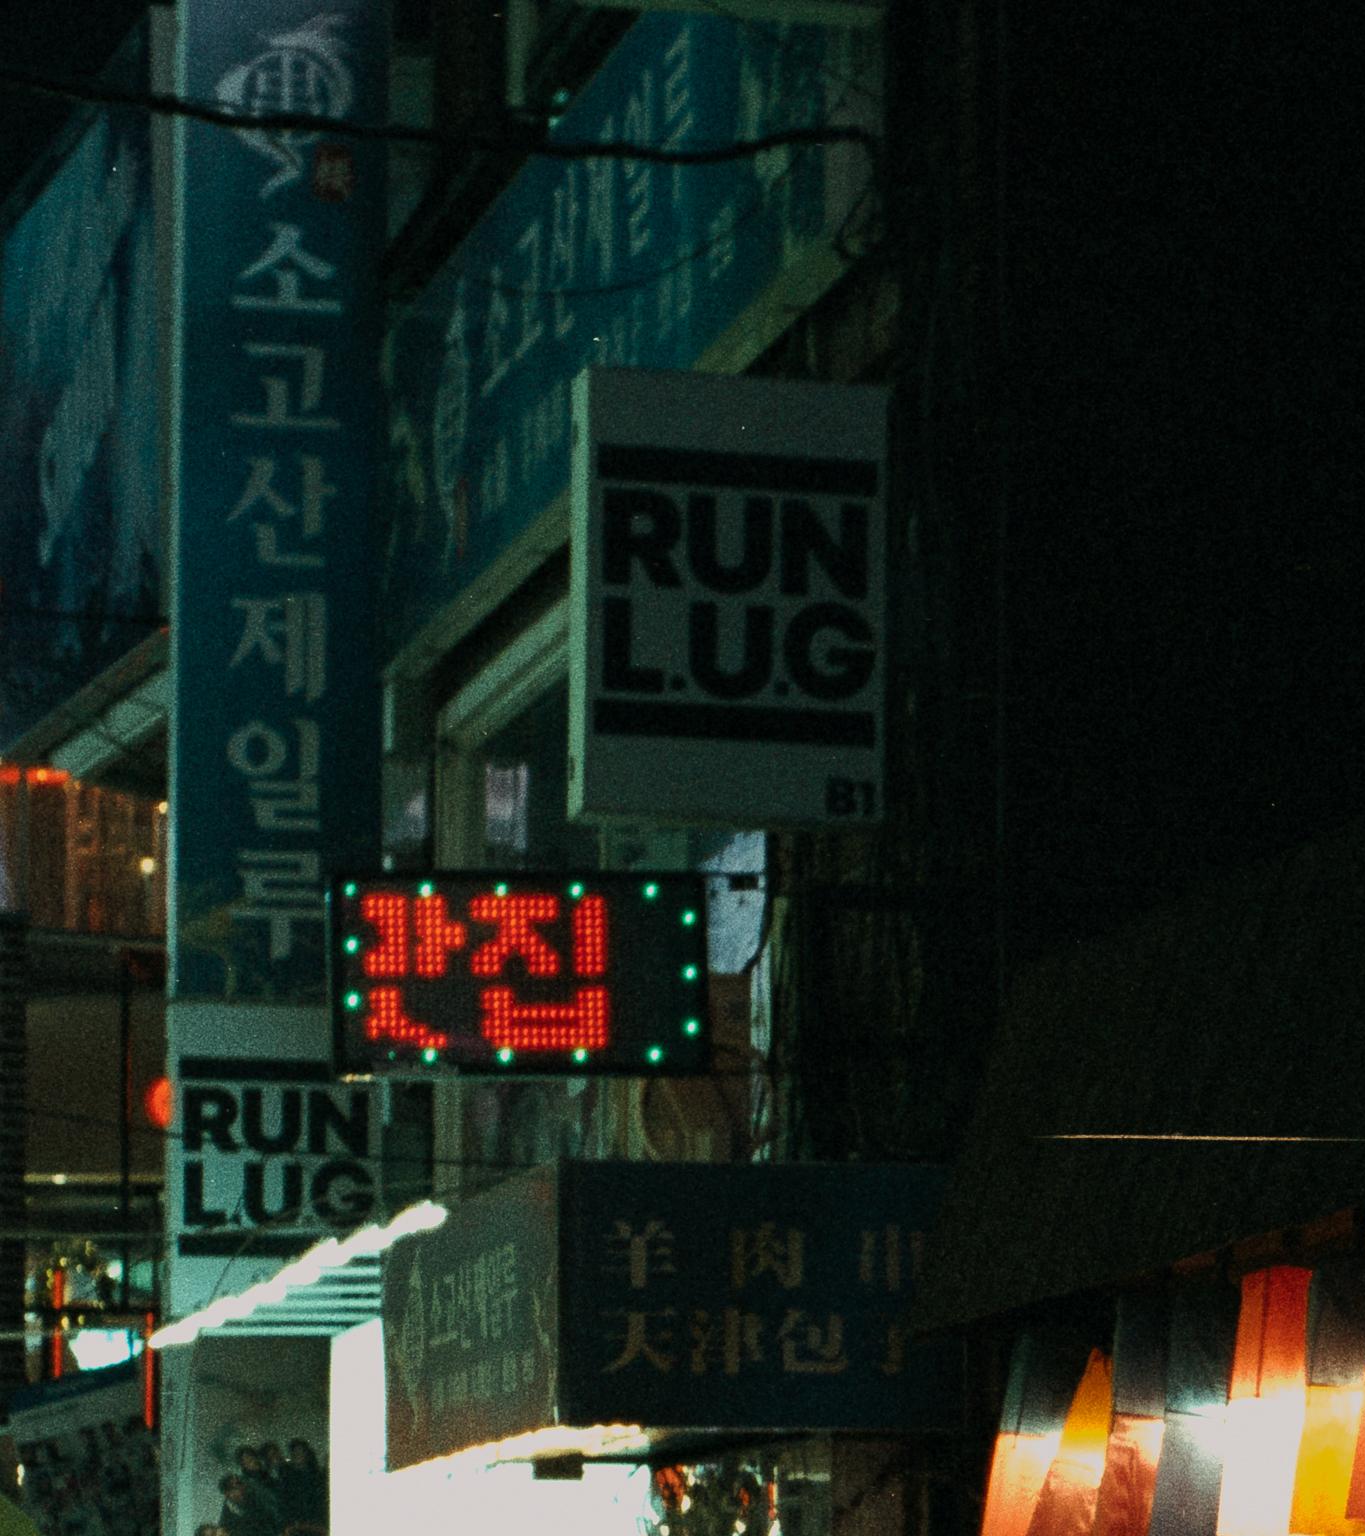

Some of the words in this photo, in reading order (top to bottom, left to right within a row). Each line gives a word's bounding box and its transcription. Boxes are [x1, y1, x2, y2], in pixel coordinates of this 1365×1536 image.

[228, 221, 344, 961] 소고산제일루
[602, 486, 869, 600] RUN
[602, 596, 877, 701] L.U.G
[184, 1085, 371, 1157] RUN
